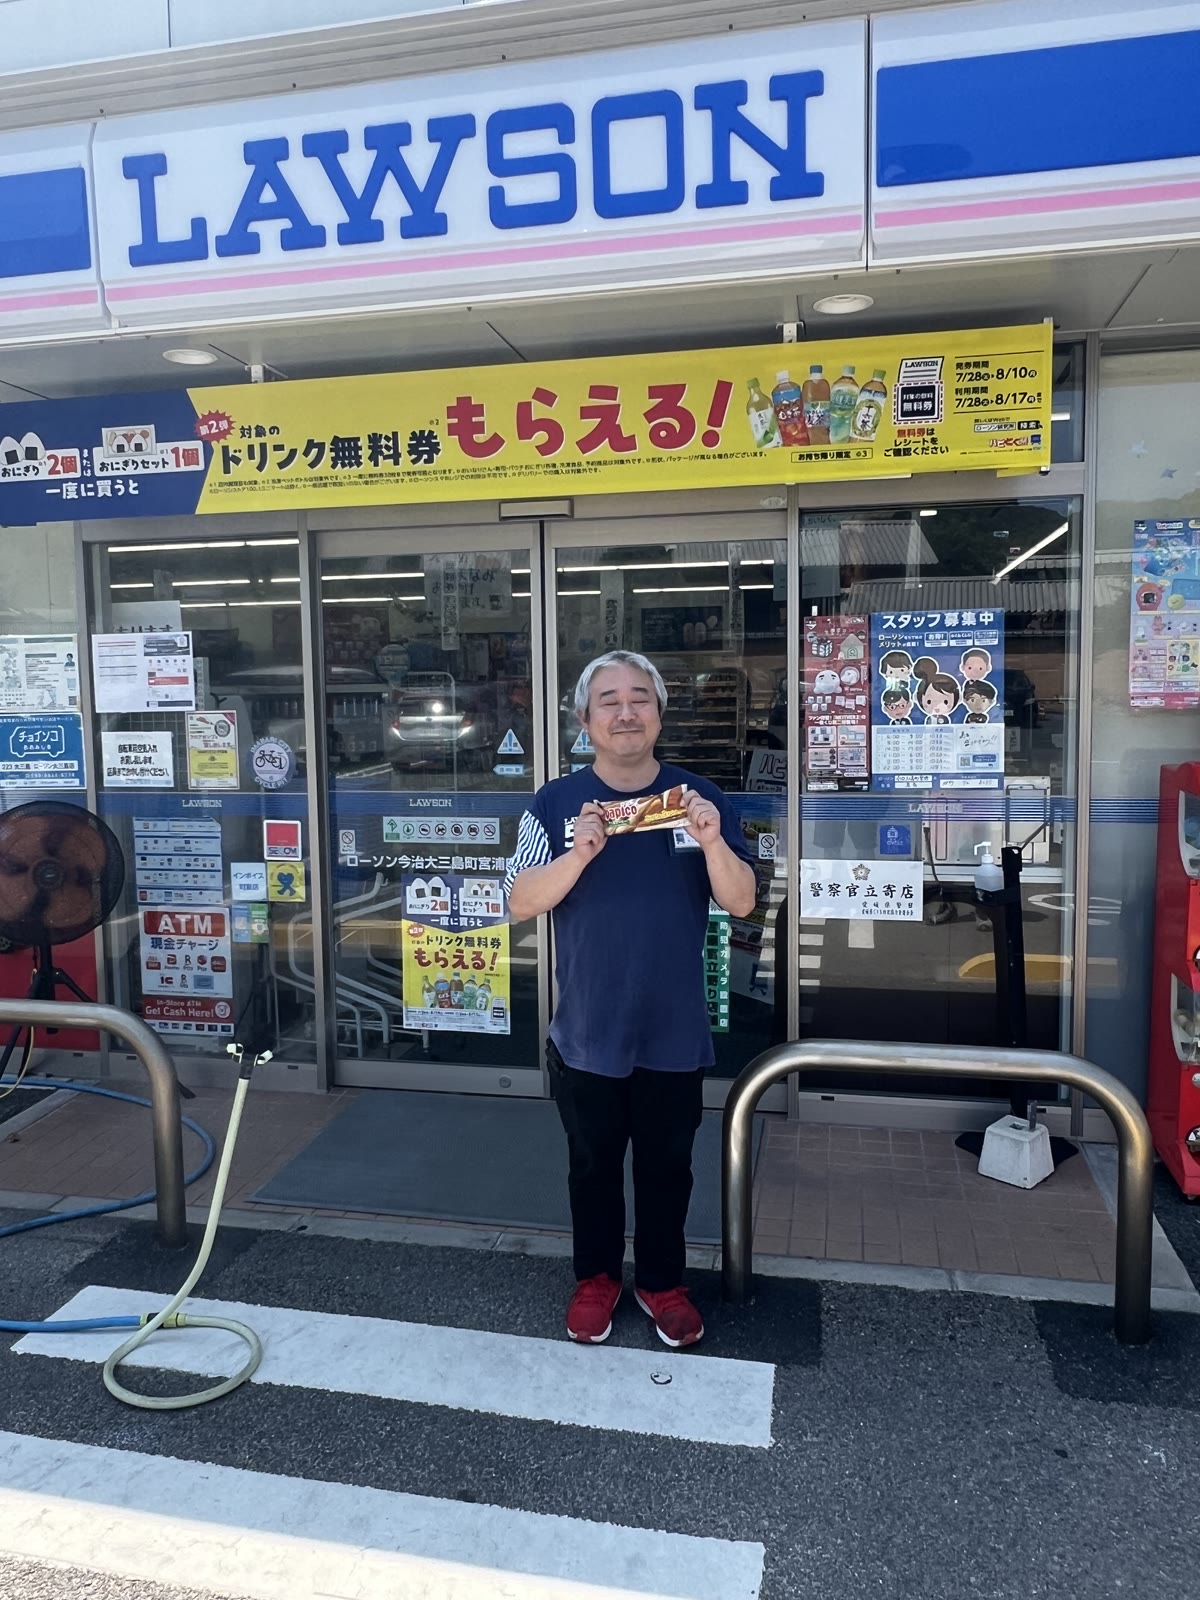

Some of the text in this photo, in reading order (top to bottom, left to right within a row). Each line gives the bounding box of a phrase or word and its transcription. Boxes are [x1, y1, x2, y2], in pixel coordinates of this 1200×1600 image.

[122, 70, 824, 269] LAWSON
[905, 360, 939, 369] LAWSON
[956, 361, 990, 371] 発券期間
[955, 386, 989, 396] 利用期間
[903, 402, 933, 412] 無料券
[446, 379, 734, 459] もらえる!
[200, 419, 229, 436] 第2弾
[240, 425, 281, 439] 対象の
[897, 428, 935, 438] 無料券は
[894, 437, 939, 447] レシートを
[221, 430, 442, 475] ドリンク無料券
[798, 451, 852, 461] お持ち帰り限定
[884, 446, 949, 457] ご確認ください
[83, 449, 92, 477] または
[99, 457, 170, 472] おにぎりセット
[171, 446, 200, 468] 1個
[1, 465, 40, 477] おにぎり
[47, 454, 78, 475] 2個
[46, 479, 139, 500] 一度に買うと
[882, 611, 994, 629] スタッフ募集中
[19, 730, 58, 742] チョイソコ
[182, 800, 222, 808] LAWSON
[409, 799, 452, 807] LAWSON
[268, 847, 297, 855] SECOM
[233, 872, 264, 880] インボイス
[810, 882, 914, 899] 警察官立寄店
[431, 900, 449, 911] 2個
[484, 902, 500, 913] 1個
[158, 914, 212, 935] ATM
[431, 916, 483, 926] 一度に買うと
[151, 937, 219, 950] 現金チャージ
[426, 935, 502, 949] ドリンク無料券
[414, 948, 498, 971] もらえる!
[146, 1006, 214, 1018] Get Cash Here!
